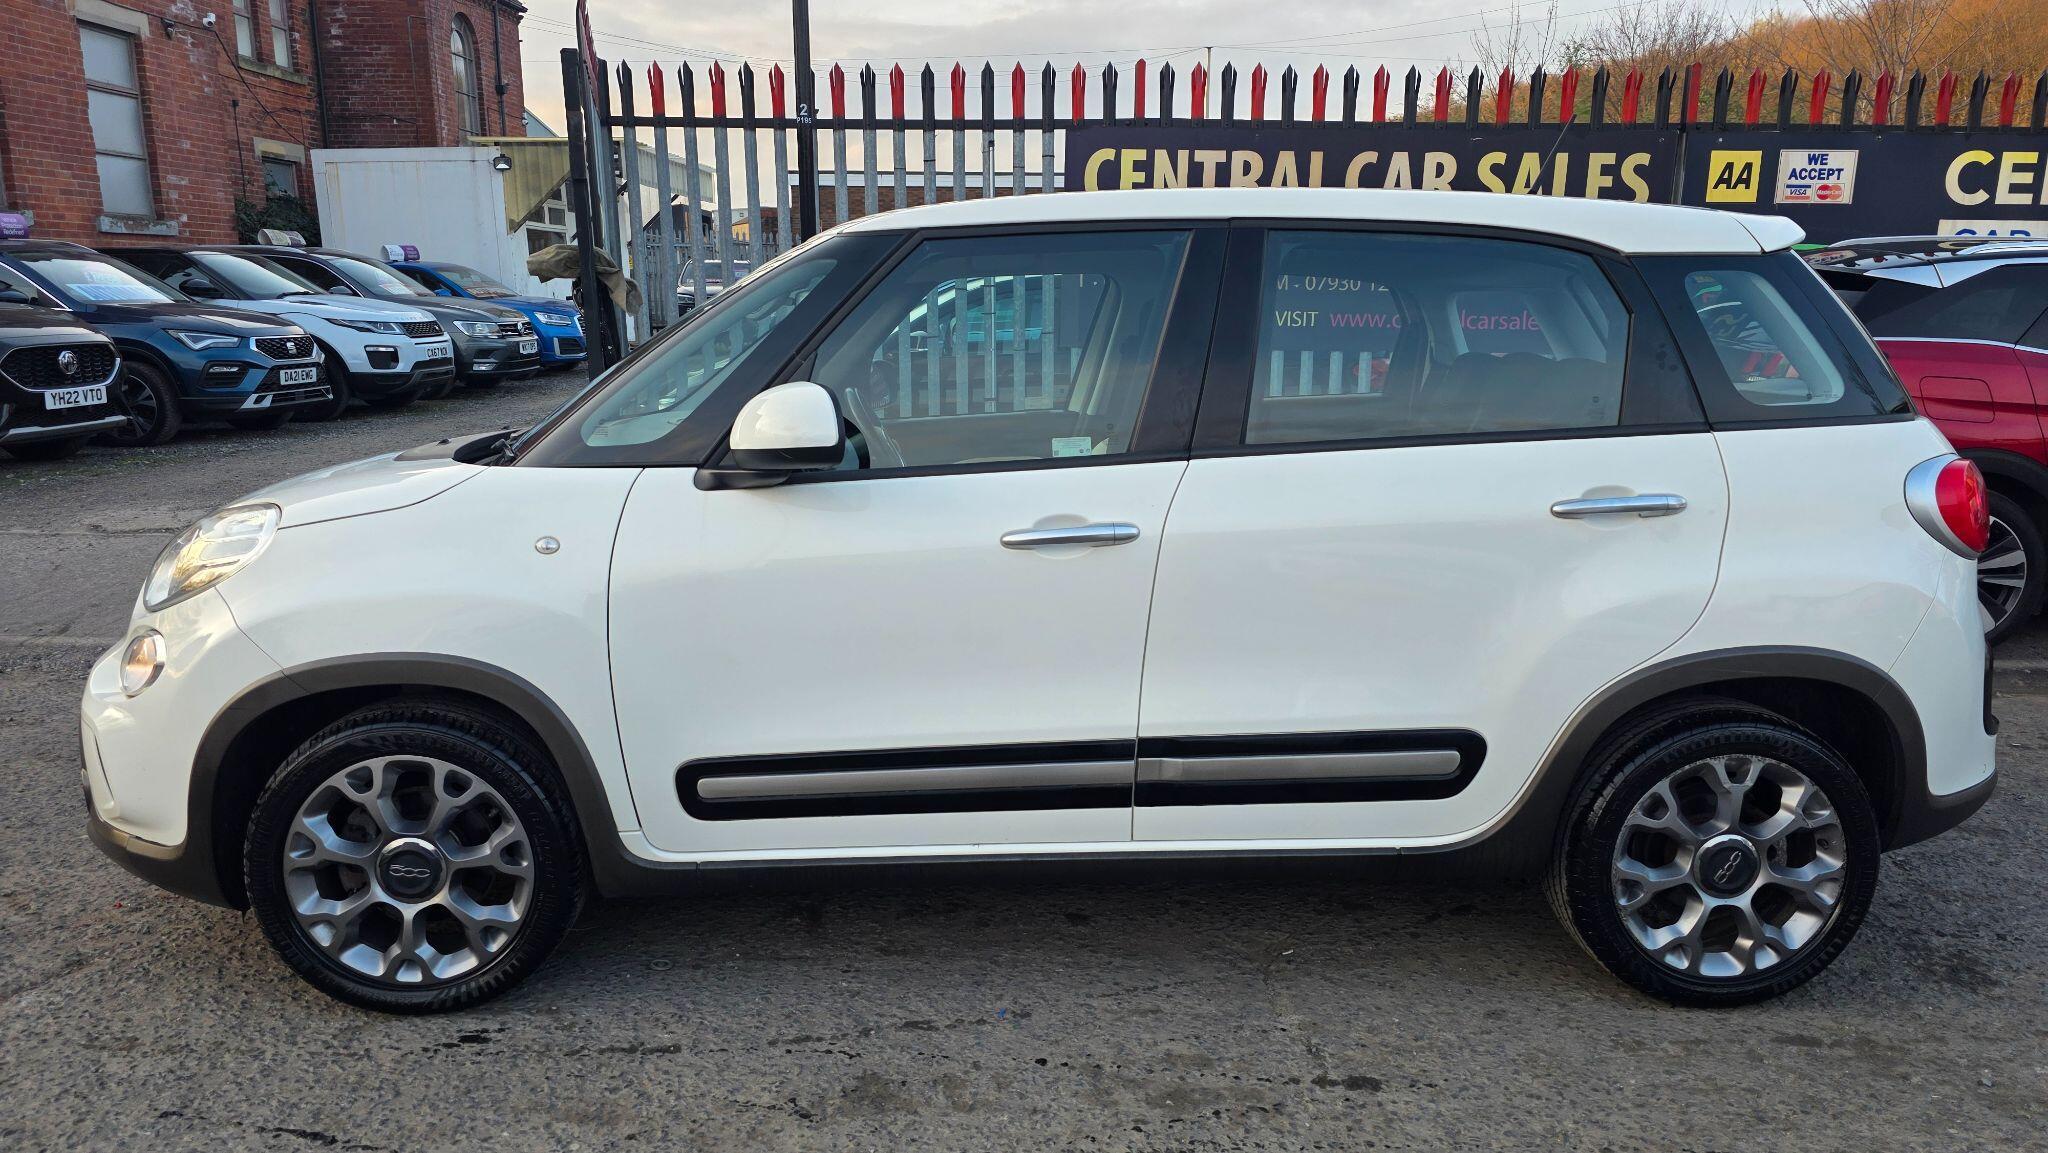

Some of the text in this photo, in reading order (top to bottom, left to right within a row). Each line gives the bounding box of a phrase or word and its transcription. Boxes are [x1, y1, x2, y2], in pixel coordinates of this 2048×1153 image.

[800, 103, 808, 116] 2
[1807, 153, 1829, 166] WE
[1344, 150, 1458, 191] CAR
[1712, 161, 1754, 190] AA
[1788, 167, 1844, 181] ACCEPT
[1945, 149, 2048, 206] CE
[1789, 188, 1807, 196] VISA
[1275, 310, 1319, 327] VISIT
[50, 388, 103, 407] YH22 VTO
[389, 864, 431, 878] 500
[1714, 850, 1742, 884] 500
